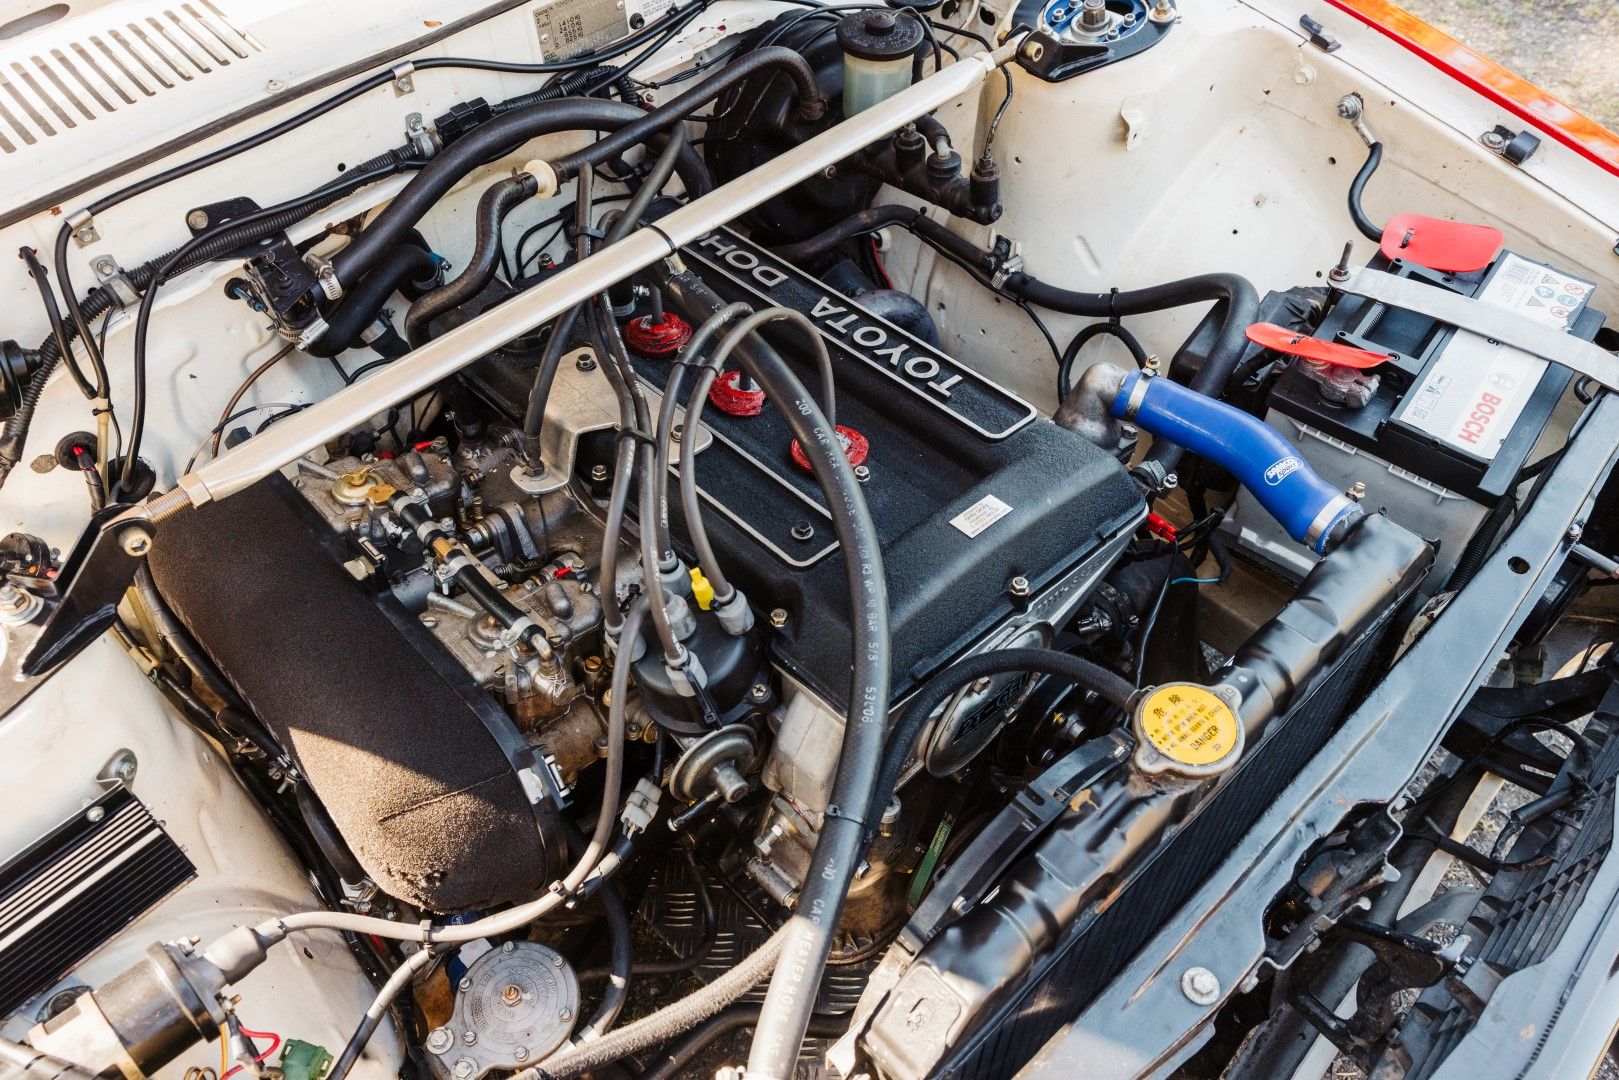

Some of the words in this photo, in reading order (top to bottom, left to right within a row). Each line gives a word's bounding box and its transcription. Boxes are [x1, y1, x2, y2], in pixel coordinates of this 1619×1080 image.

[697, 231, 789, 287] DOH
[810, 296, 963, 397] TOYOTA
[1457, 392, 1503, 445] BOSCH
[866, 612, 878, 632] BAR
[1189, 725, 1221, 751] DANGER
